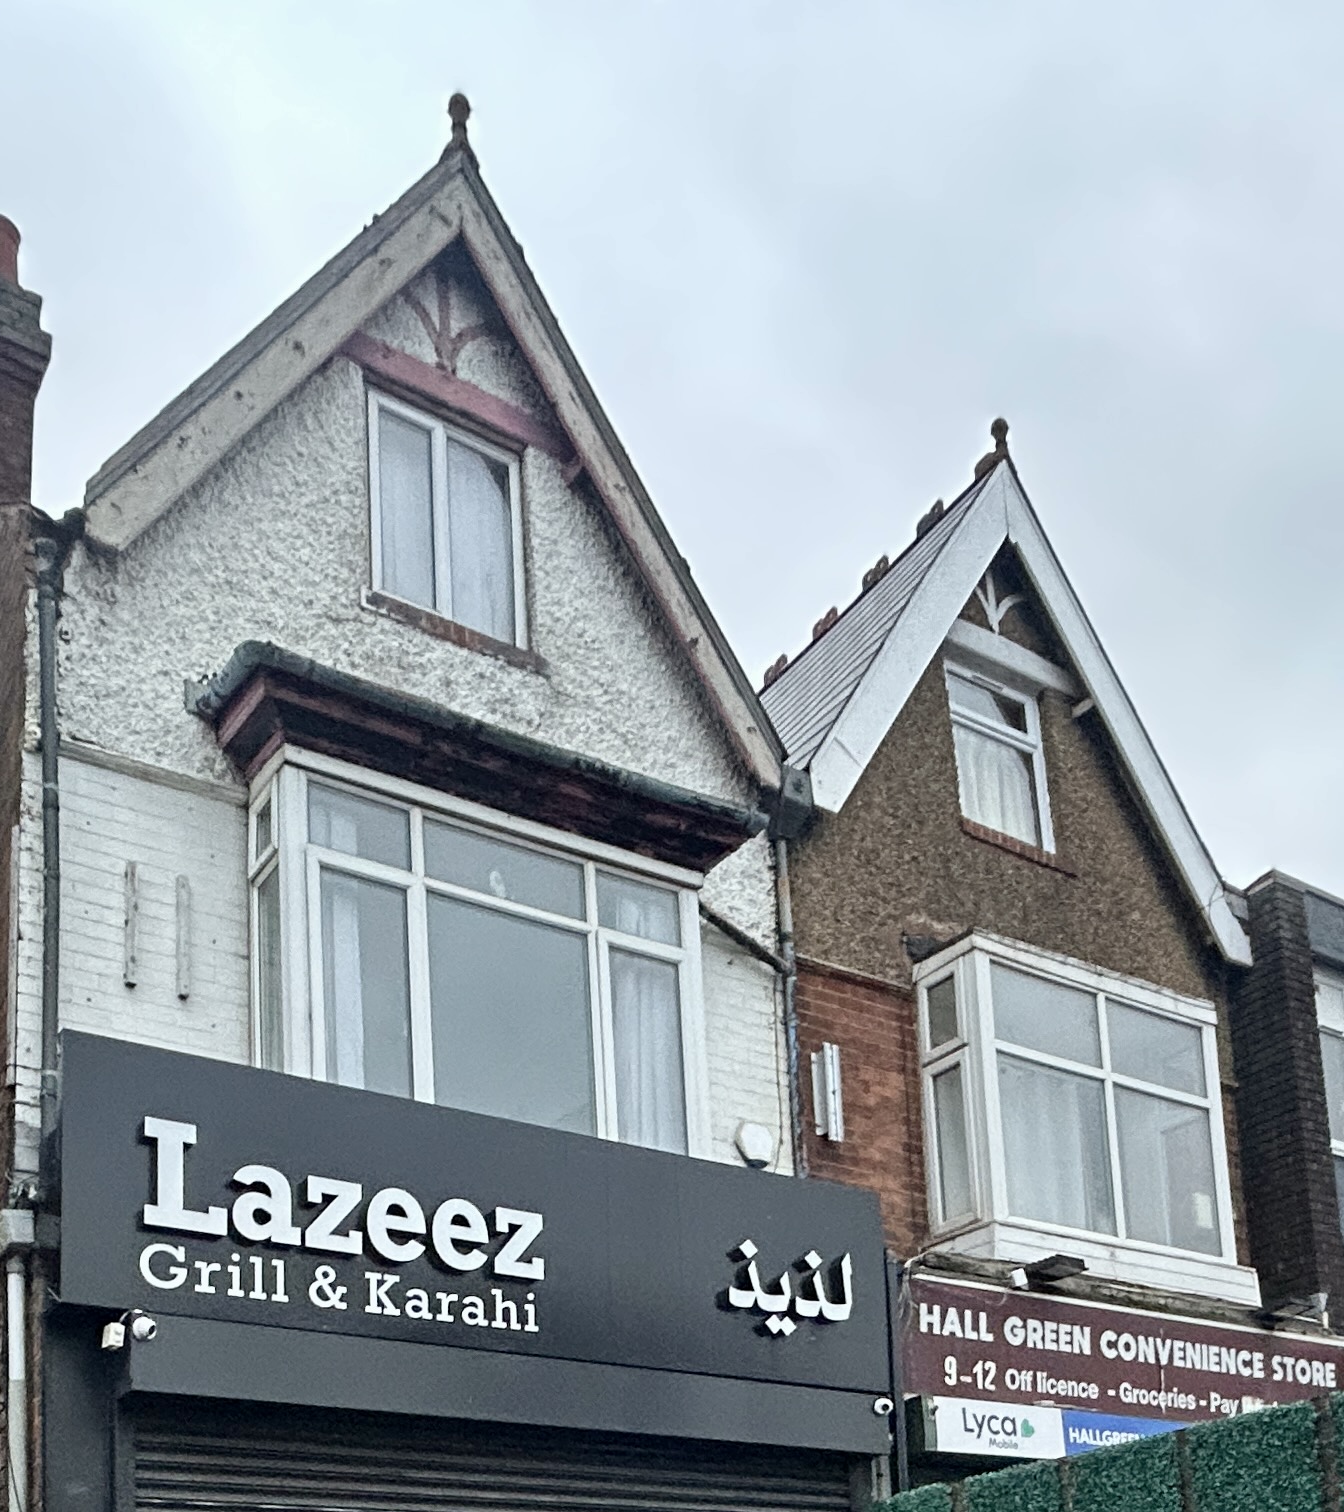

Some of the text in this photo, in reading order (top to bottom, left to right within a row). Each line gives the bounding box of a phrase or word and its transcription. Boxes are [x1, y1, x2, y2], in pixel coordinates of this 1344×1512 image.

[143, 1115, 545, 1281] Lazeez
[139, 1243, 540, 1333] Grill & Karahi
[729, 1239, 853, 1336] لذيذ
[919, 1302, 1337, 1388] HALL GREEN CONVENIENCE STORE
[943, 1355, 997, 1392] 9-12
[1005, 1367, 1033, 1392] Off
[1037, 1371, 1100, 1400] licence
[1119, 1381, 1197, 1410] Groceries
[1209, 1391, 1240, 1418] Pay
[961, 1407, 1018, 1440] Lyca
[988, 1436, 1019, 1450] Mobile
